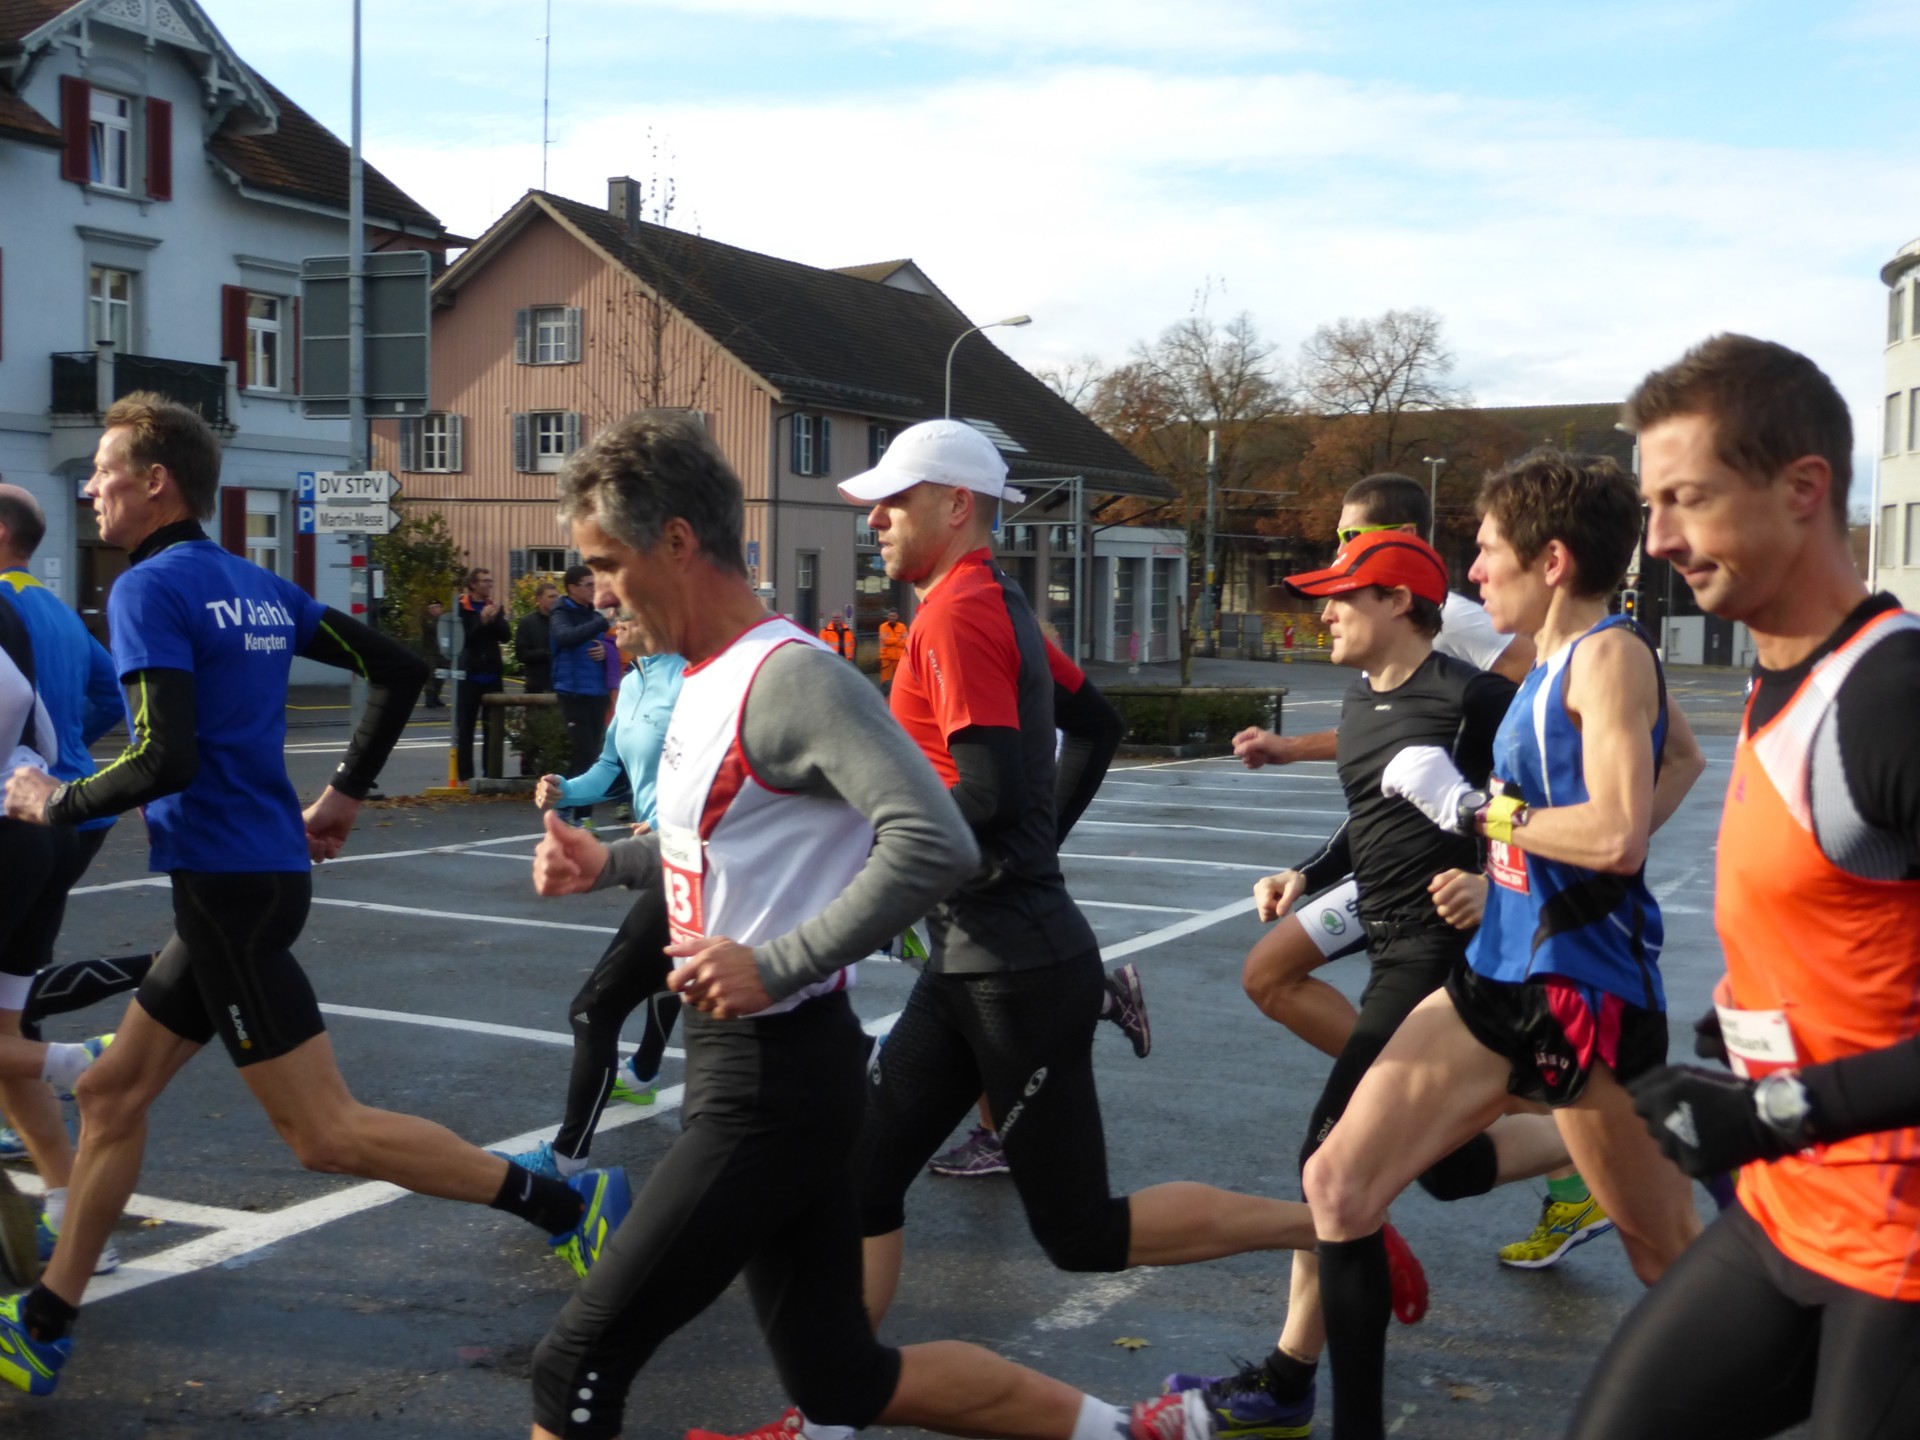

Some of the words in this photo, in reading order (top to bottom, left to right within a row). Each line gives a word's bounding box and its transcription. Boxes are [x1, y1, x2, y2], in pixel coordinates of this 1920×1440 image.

[301, 475, 314, 499] P
[320, 478, 340, 494] DV
[346, 478, 383, 494] STPV
[300, 506, 314, 531] P
[319, 511, 384, 527] Martini-Messe
[205, 597, 242, 629] TV
[244, 633, 287, 655] Kempten
